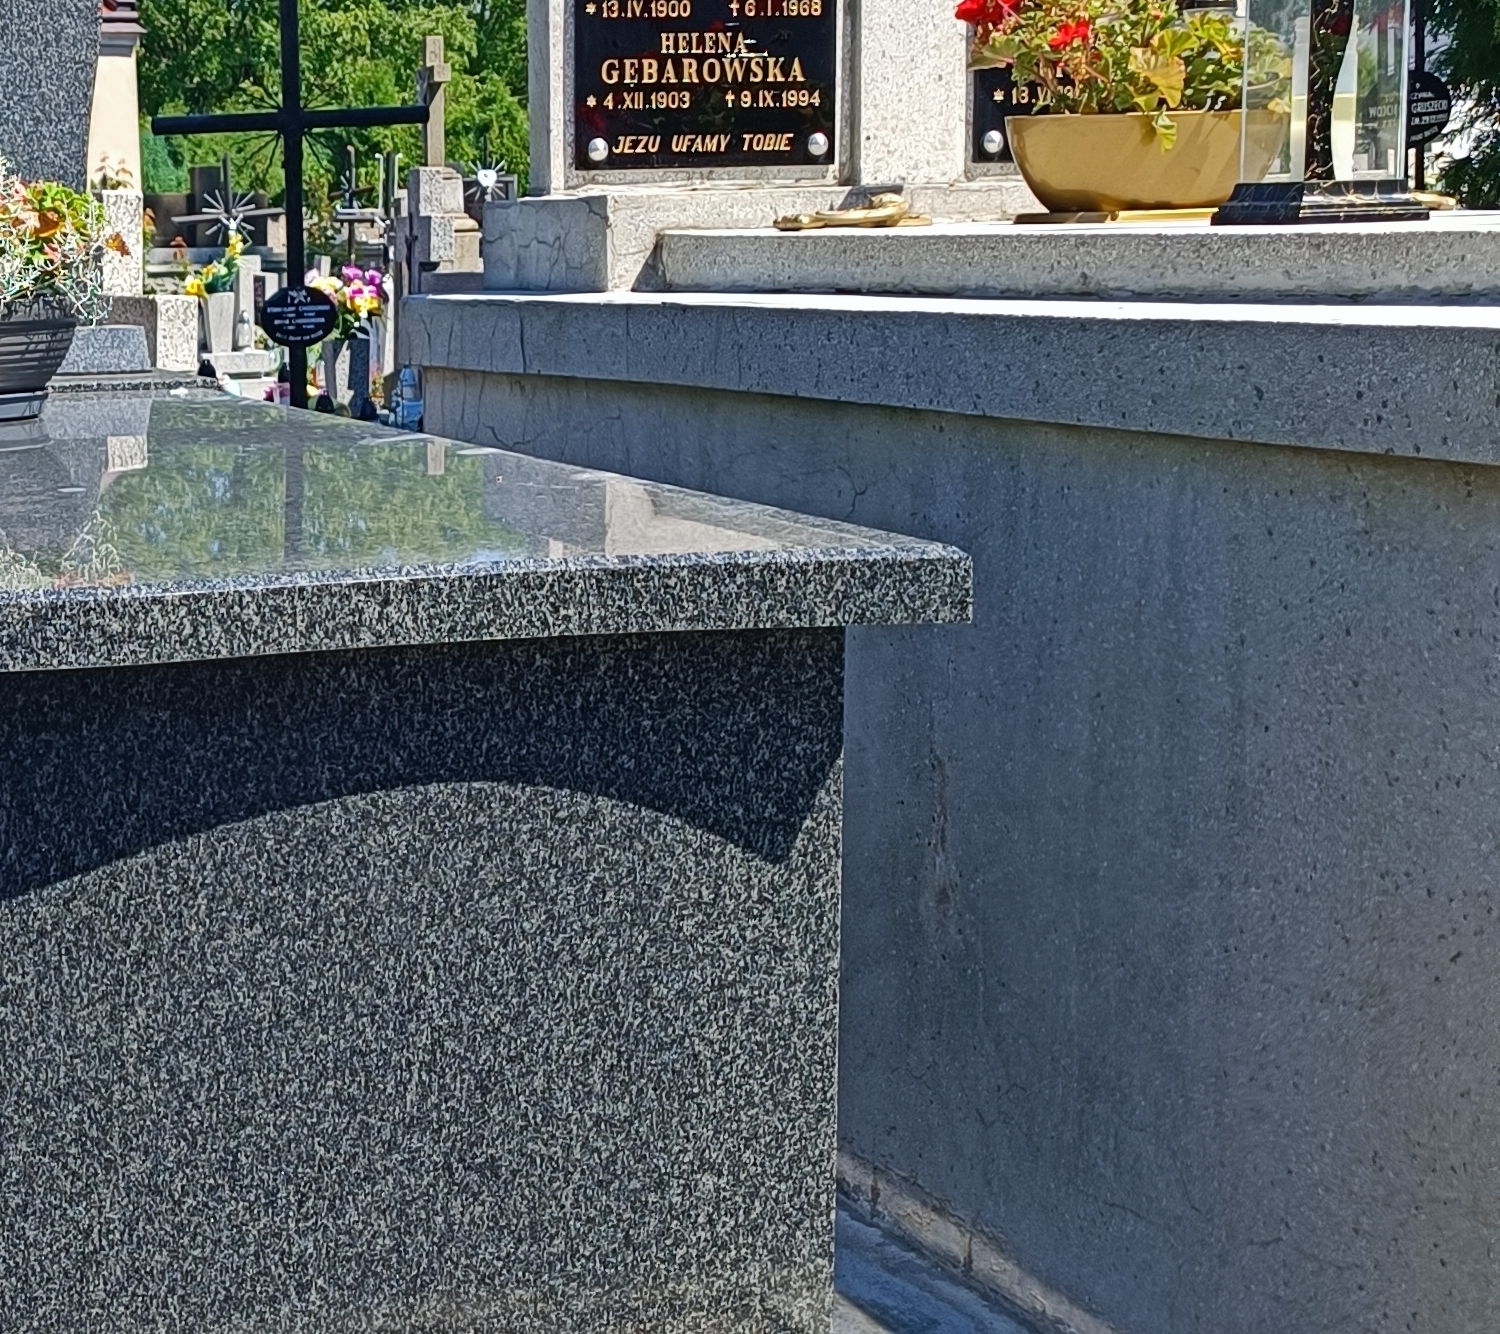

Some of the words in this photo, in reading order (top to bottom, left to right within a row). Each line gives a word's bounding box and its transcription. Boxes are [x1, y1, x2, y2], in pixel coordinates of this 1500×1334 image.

[660, 32, 748, 54] HELENA
[601, 57, 806, 87] GĘBAROWSKA
[612, 134, 660, 154] JEZU
[672, 133, 731, 153] UFAMY
[741, 132, 794, 152] TOBIE
